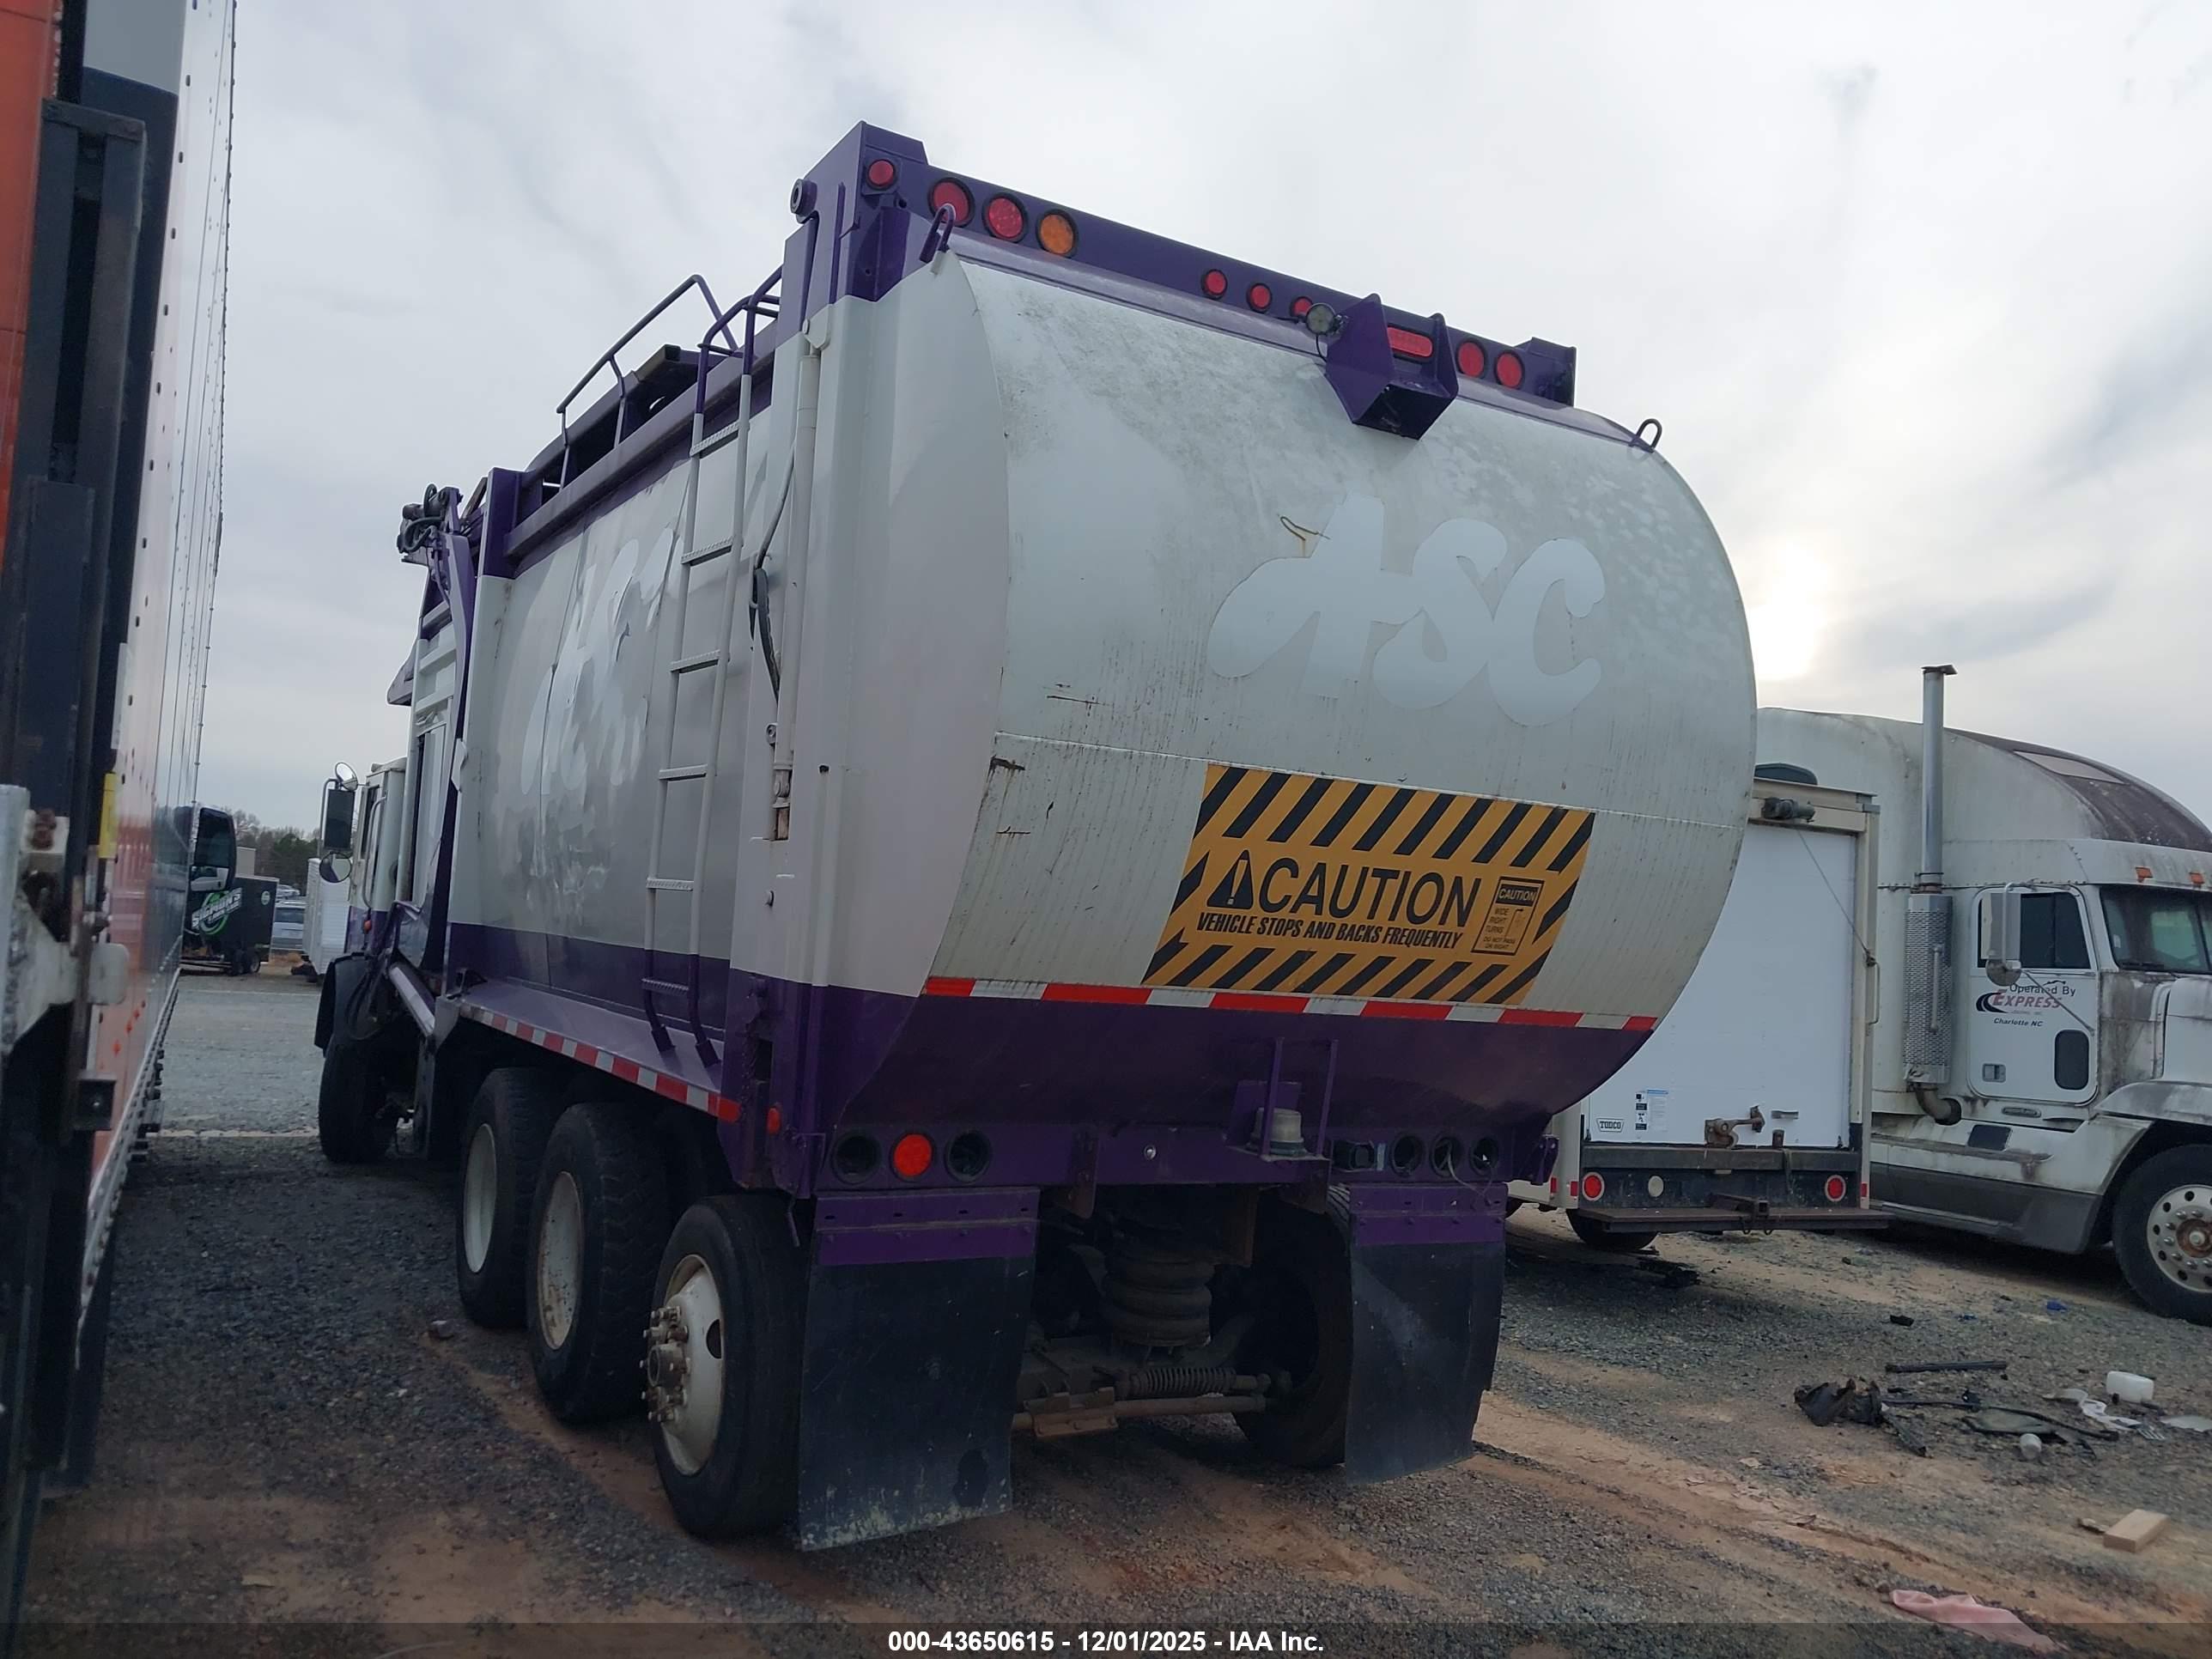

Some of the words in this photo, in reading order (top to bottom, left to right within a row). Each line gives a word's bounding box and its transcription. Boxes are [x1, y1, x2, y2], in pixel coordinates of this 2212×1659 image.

[1259, 857, 1481, 927] CAUTION
[1498, 888, 1536, 901] CAUTION
[1197, 912, 1258, 935] VEHICLE
[1257, 917, 1303, 939] STOPS
[1304, 921, 1335, 940] AND
[1336, 923, 1382, 945] BACKS
[1382, 927, 1463, 949] FREQUENTLY
[2062, 986, 2076, 996] By
[1992, 989, 2063, 1008] EXPRESS
[1993, 1018, 2029, 1026] Charlotte
[1600, 1121, 1621, 1129] TODCO
